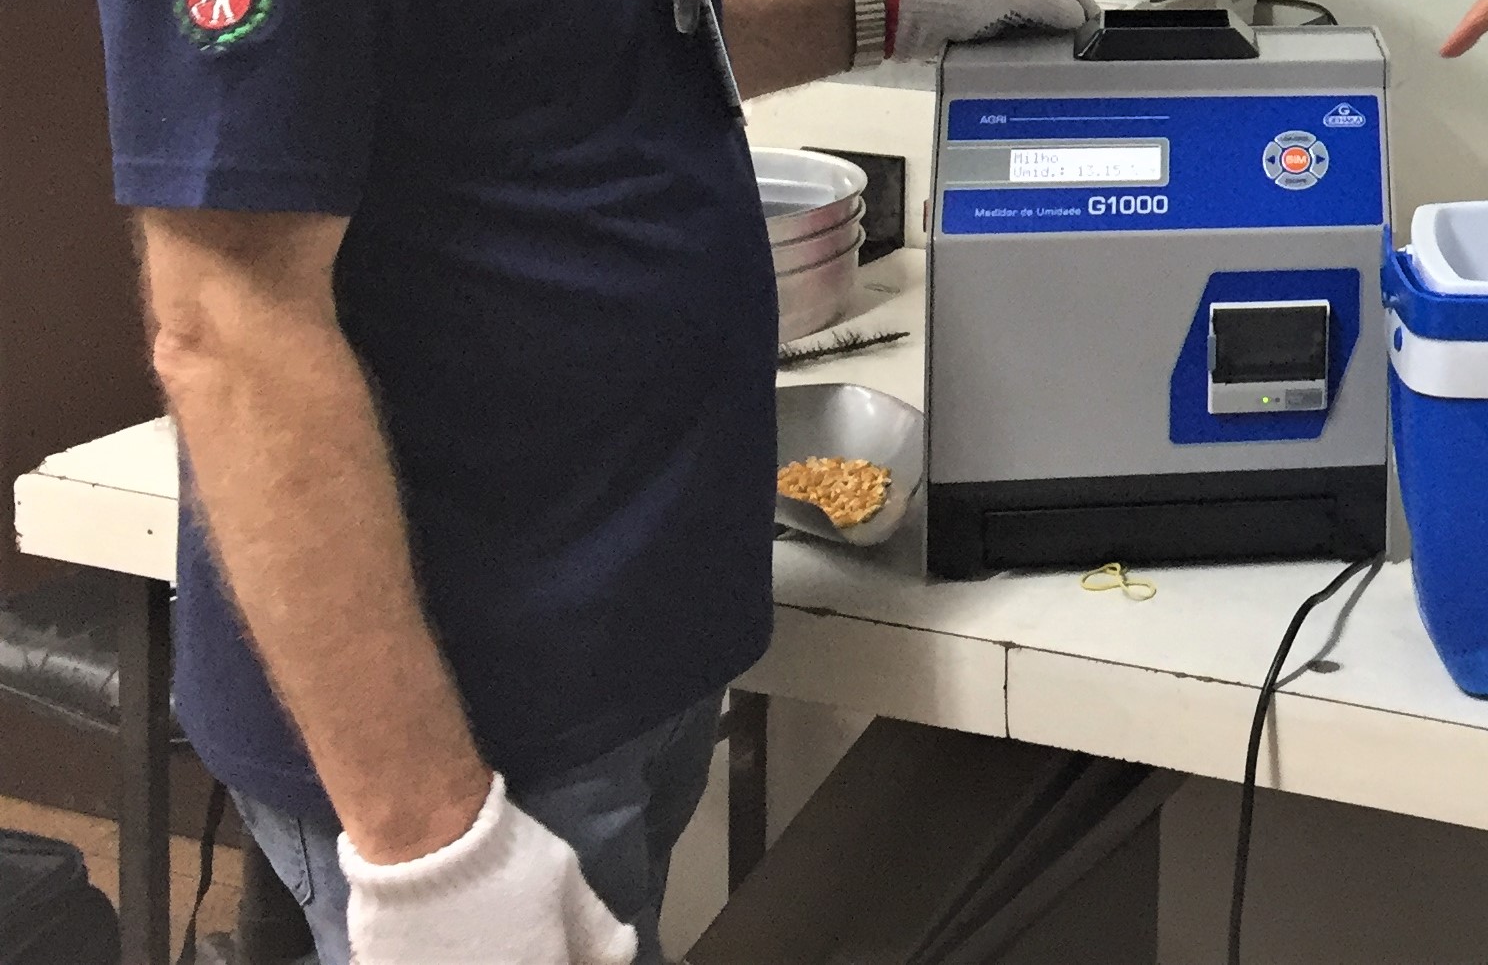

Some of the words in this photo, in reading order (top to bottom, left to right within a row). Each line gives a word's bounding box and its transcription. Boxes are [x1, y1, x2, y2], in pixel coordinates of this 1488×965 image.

[980, 115, 1007, 124] AGRI
[1014, 152, 1059, 164] Milho
[1285, 155, 1307, 164] SIM
[975, 207, 1018, 217] Medidor
[1020, 208, 1033, 217] de
[1036, 207, 1081, 217] Umidade
[1088, 195, 1169, 215] G1000
